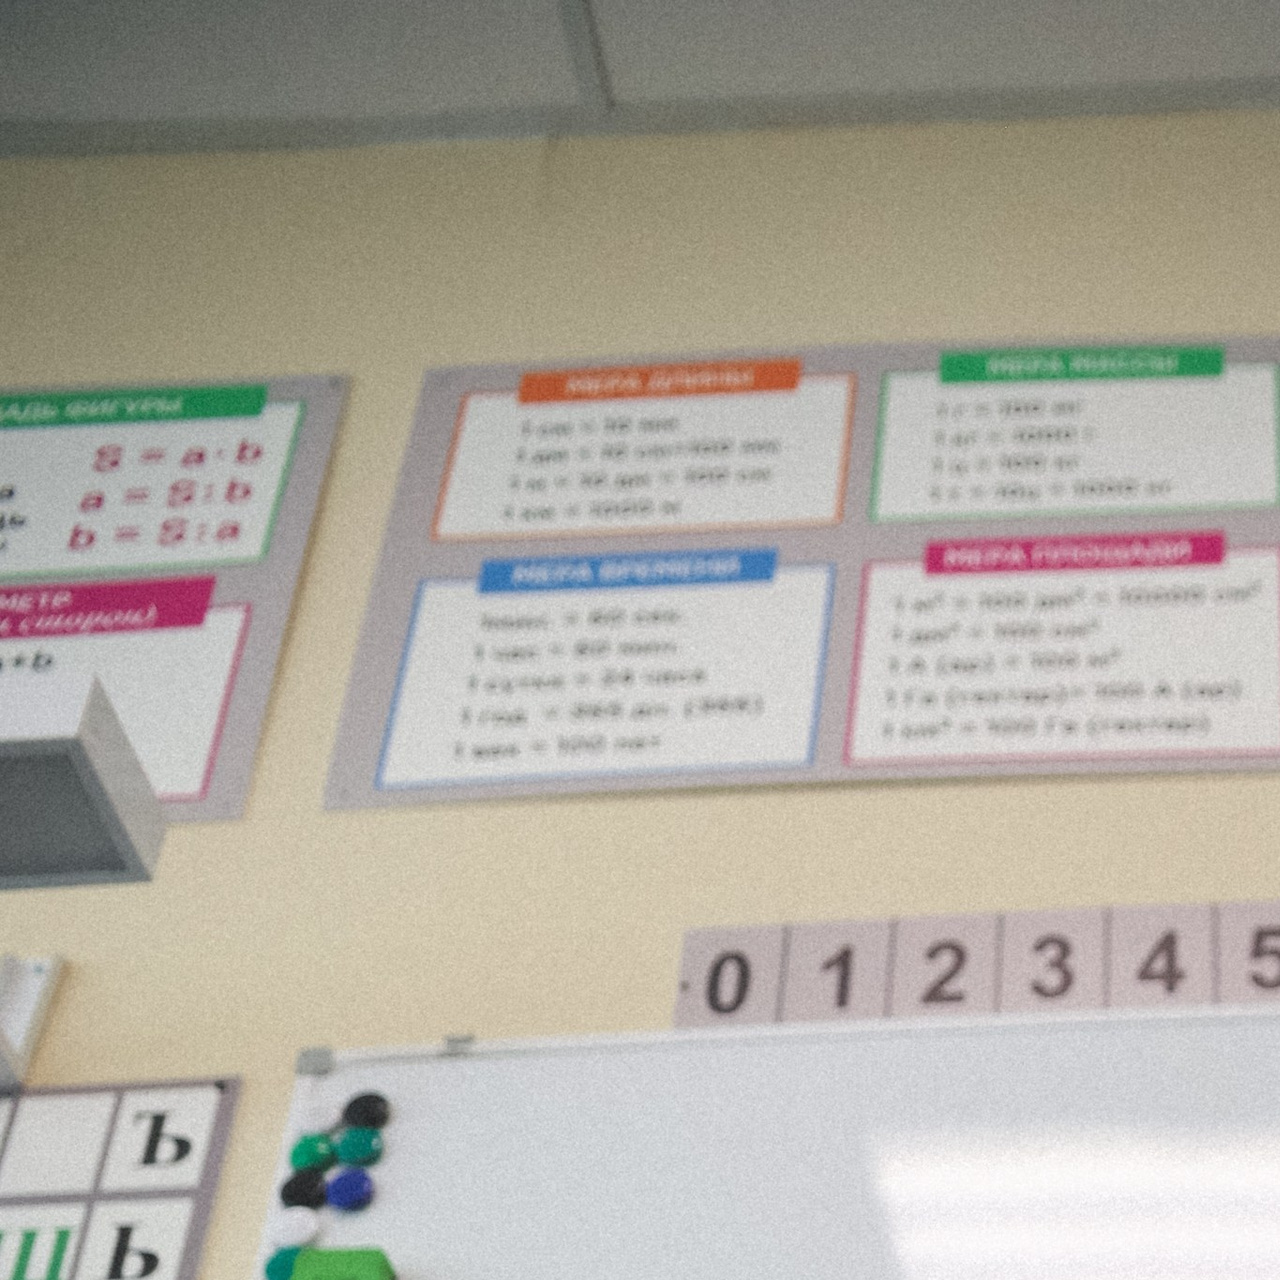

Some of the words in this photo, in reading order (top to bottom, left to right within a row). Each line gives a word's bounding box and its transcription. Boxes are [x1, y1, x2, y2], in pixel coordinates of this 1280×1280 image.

[707, 951, 751, 1014] 0
[818, 946, 855, 1008] 1
[921, 940, 969, 1003] 2
[1029, 934, 1074, 997] 3
[1137, 930, 1184, 994] 4
[133, 1111, 192, 1167] Ъ
[104, 1224, 160, 1280] Ь
